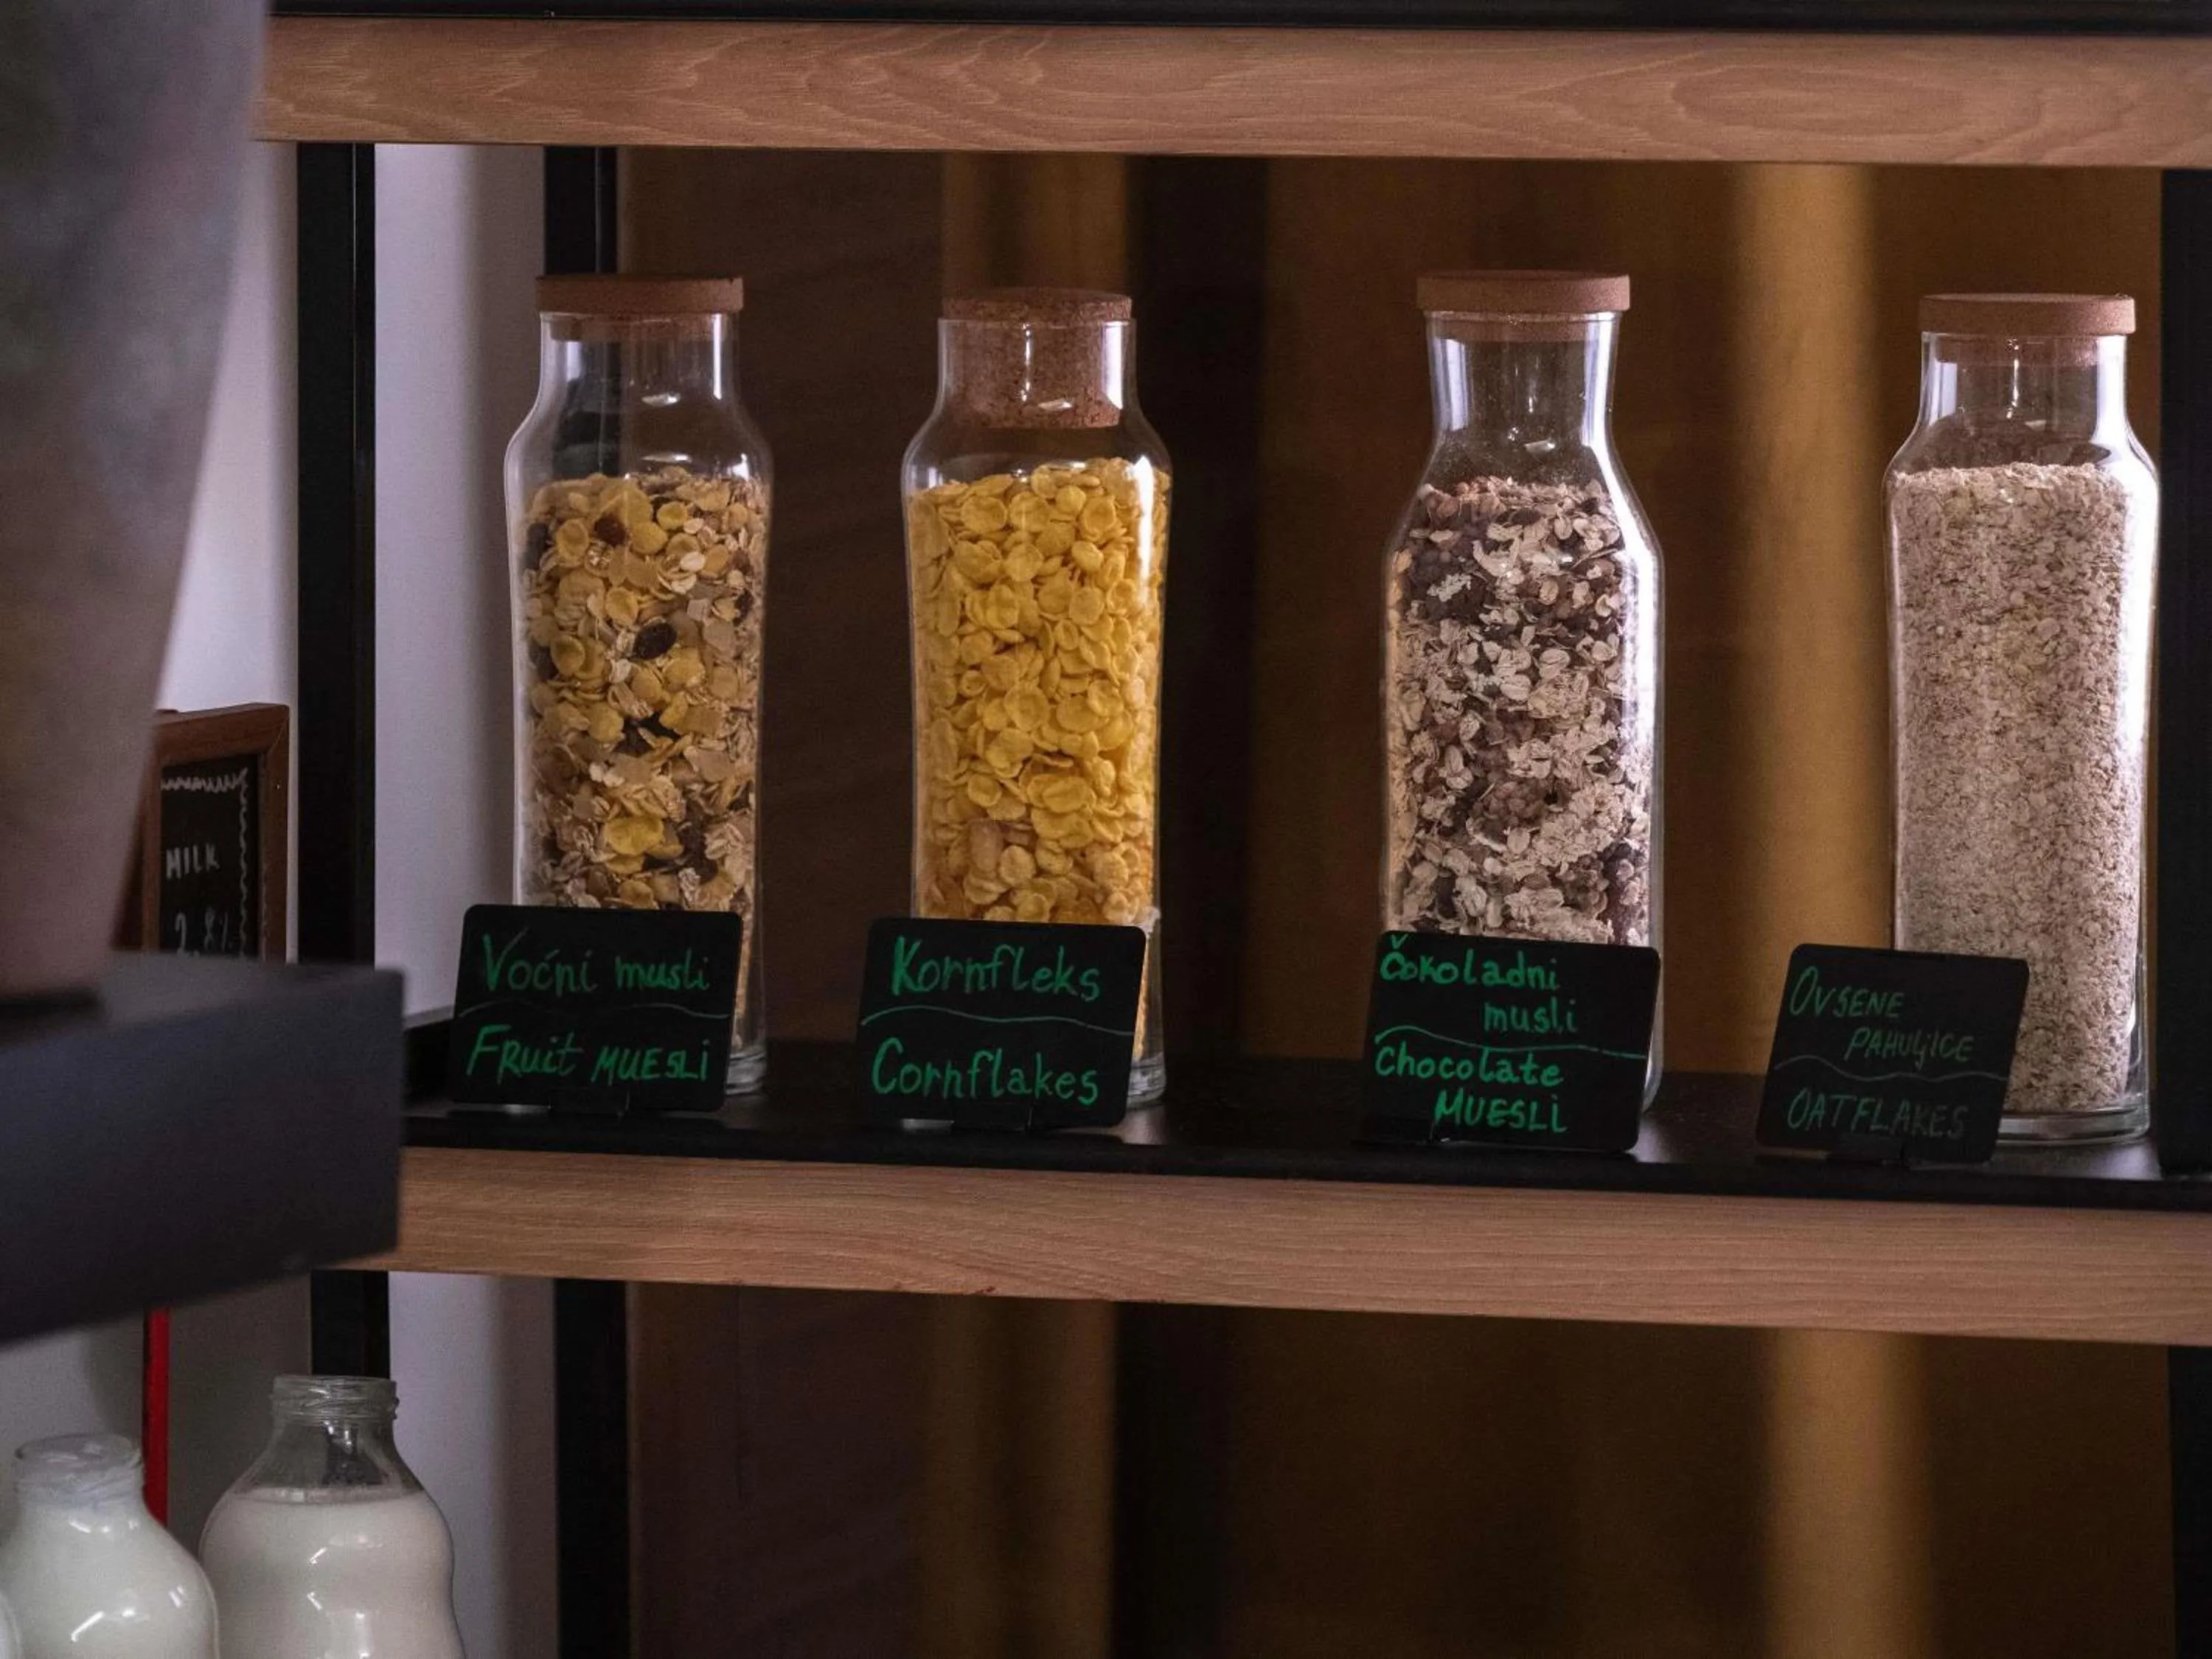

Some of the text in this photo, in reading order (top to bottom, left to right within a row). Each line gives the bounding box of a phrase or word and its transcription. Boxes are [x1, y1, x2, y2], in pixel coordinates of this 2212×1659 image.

[166, 844, 220, 881] MILK
[614, 947, 712, 992] musli
[891, 935, 1100, 1001] Kornfleks
[1484, 996, 1579, 1033] musli
[871, 1037, 1099, 1105] Cornflakes
[1374, 1040, 1565, 1087] Chocolate
[1787, 1087, 1969, 1141] OATFLAKES
